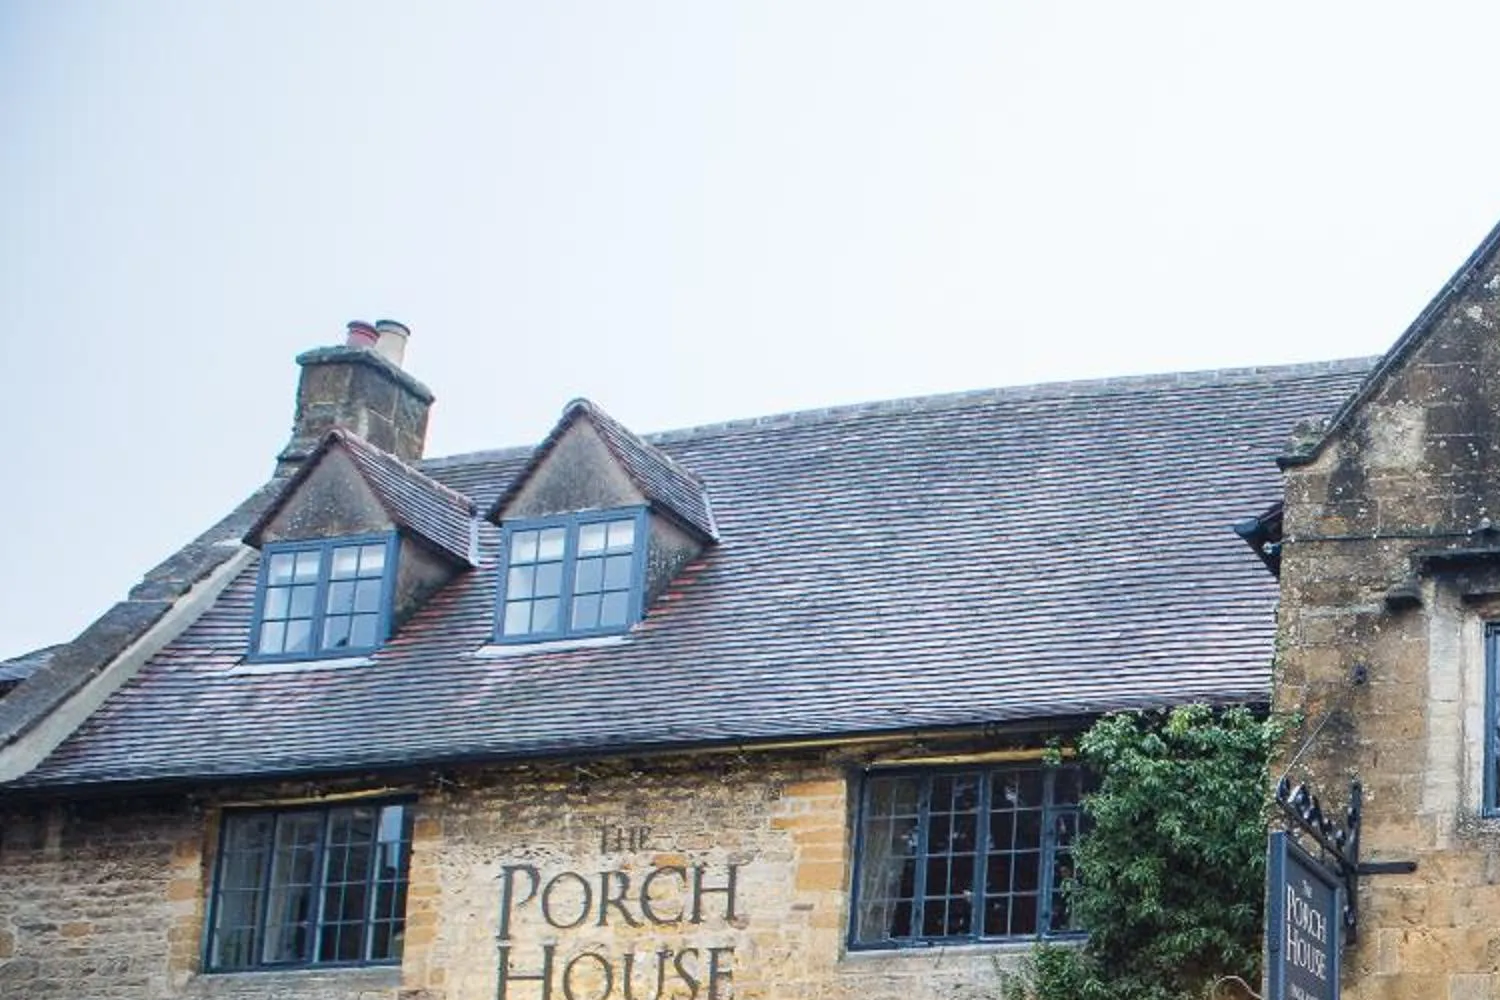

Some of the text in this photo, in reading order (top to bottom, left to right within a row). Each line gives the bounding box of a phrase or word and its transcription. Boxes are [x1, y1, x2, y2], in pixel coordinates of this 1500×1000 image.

[600, 826, 652, 854] THE
[495, 862, 739, 940] PORCH
[1287, 884, 1327, 944] PORCH
[1286, 923, 1327, 980] HOUSE
